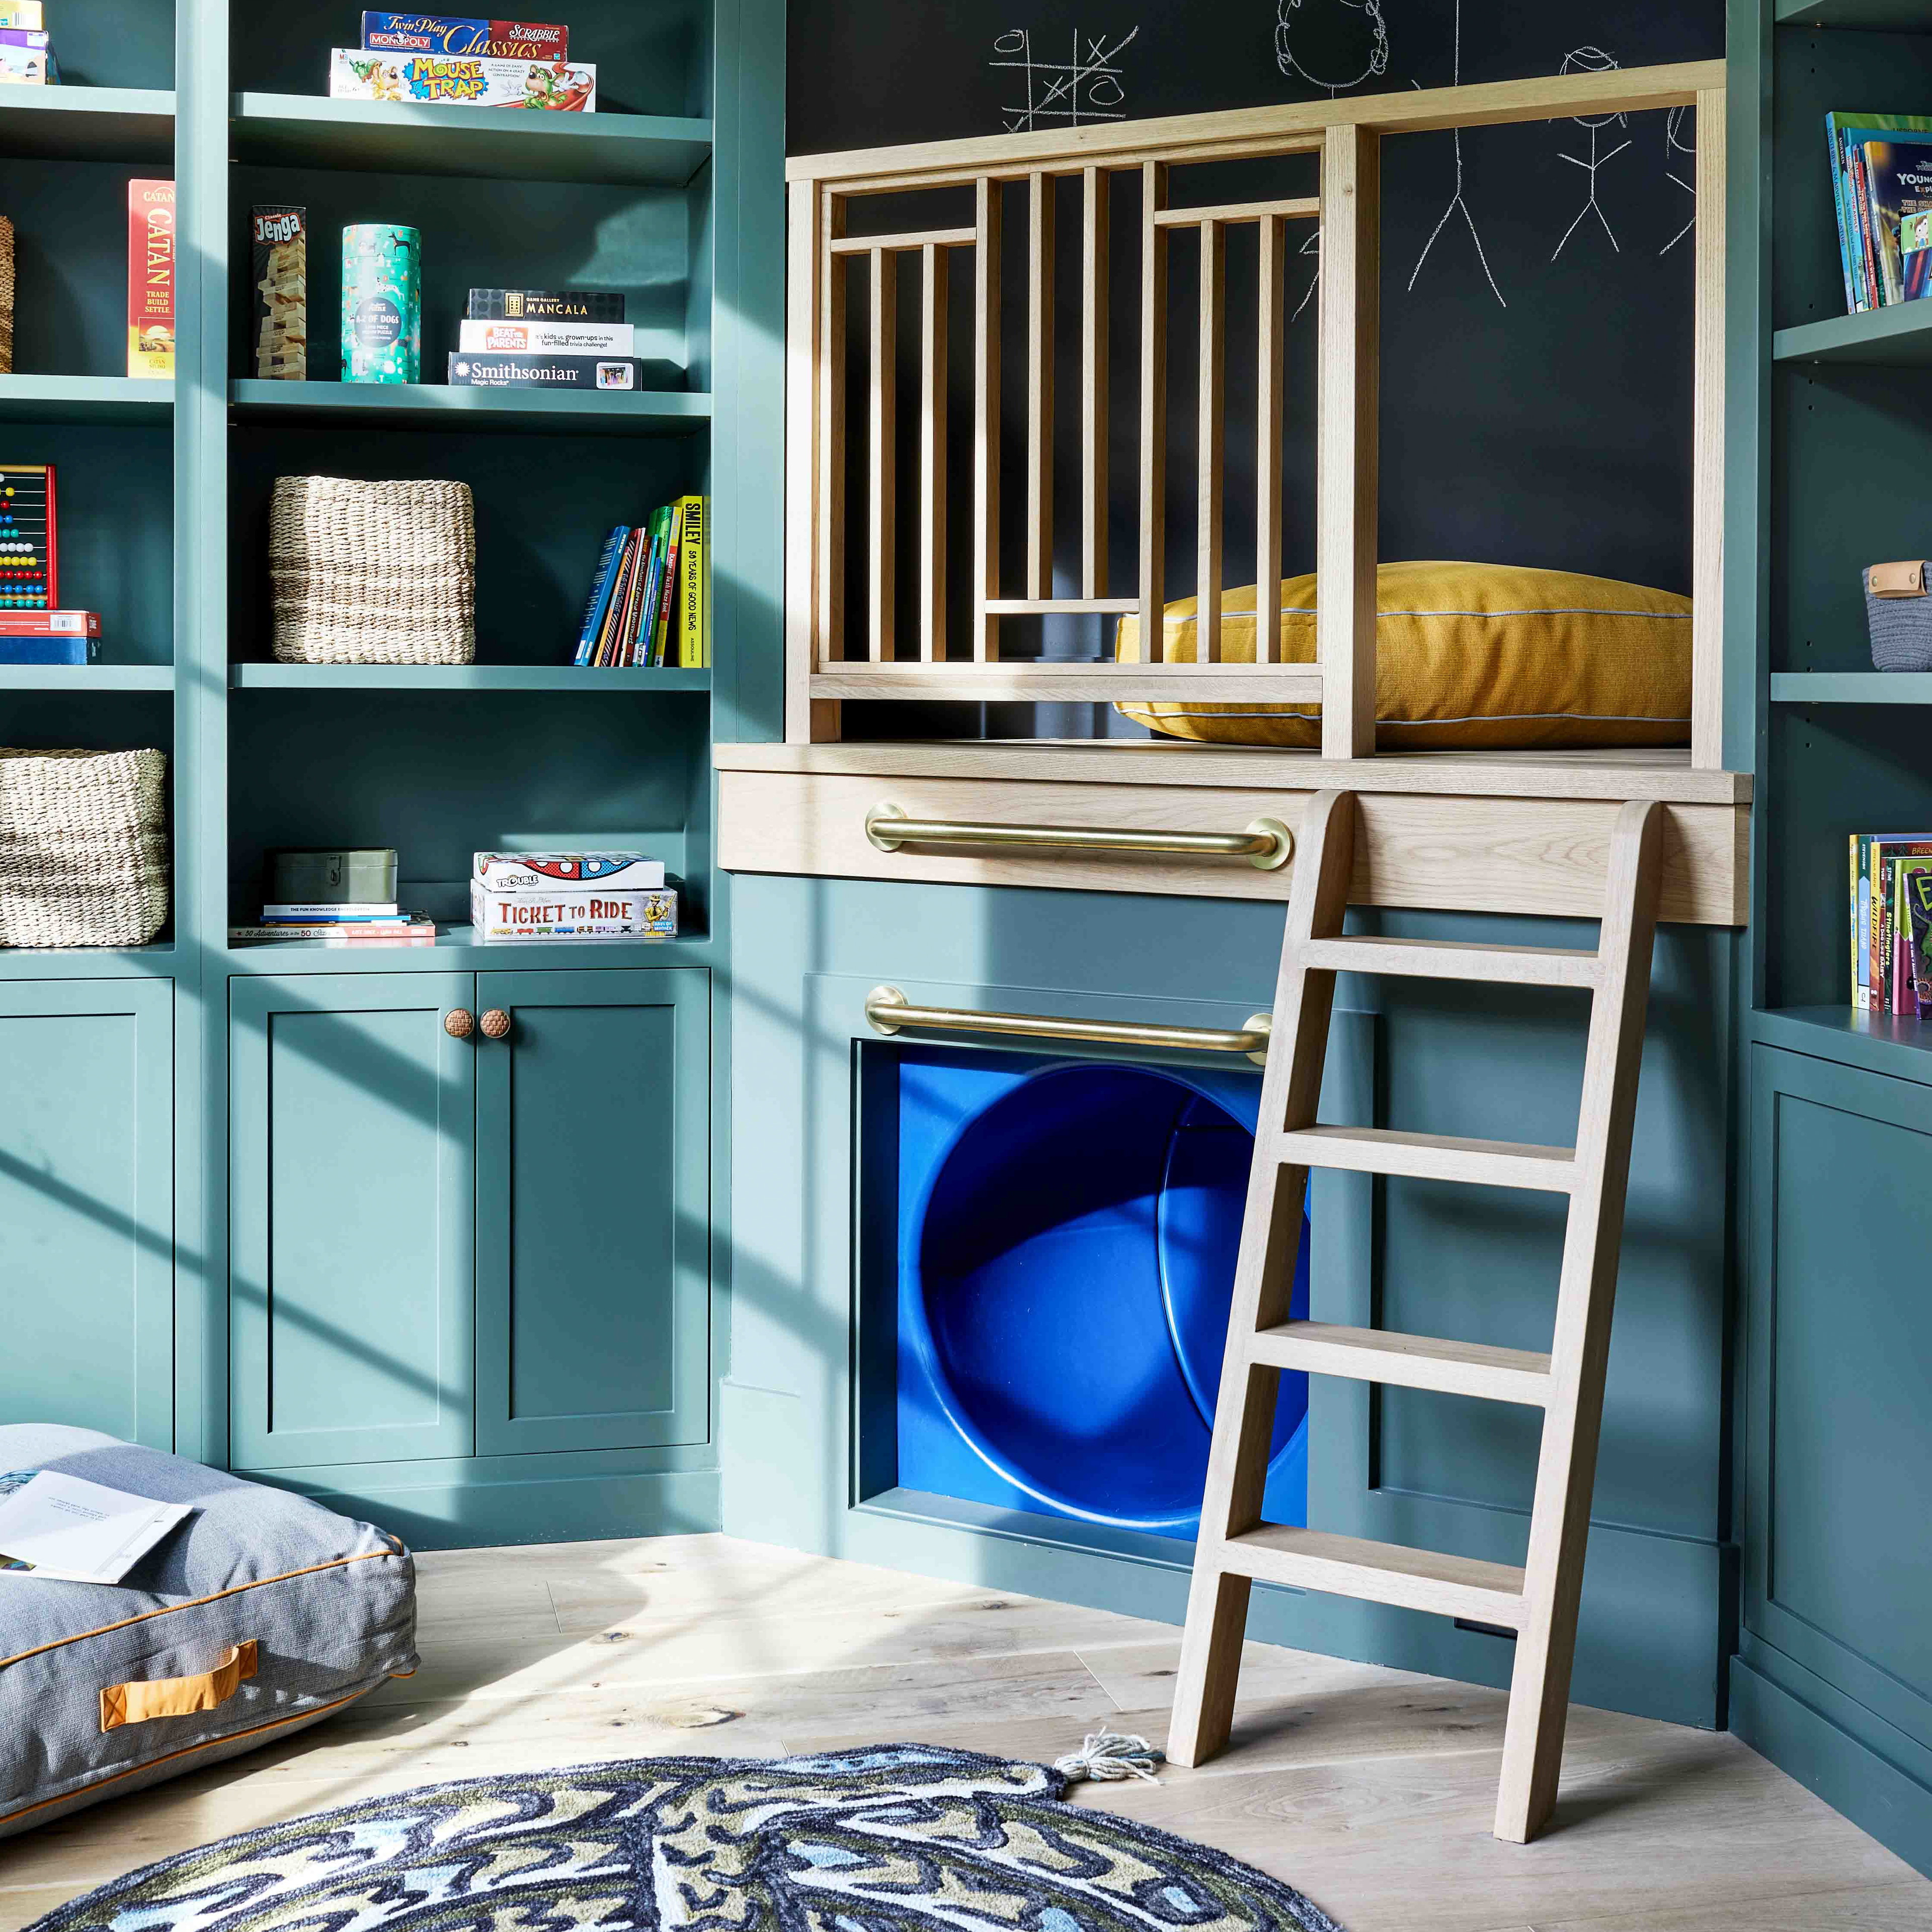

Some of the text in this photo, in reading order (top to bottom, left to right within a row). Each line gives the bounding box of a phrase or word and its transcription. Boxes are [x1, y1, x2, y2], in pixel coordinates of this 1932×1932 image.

[384, 16, 447, 37] Twin Play
[509, 24, 560, 41] SCRABBLE
[371, 35, 429, 47] MONOPOLY
[443, 25, 542, 58] Classics
[412, 57, 484, 82] MOUSE
[422, 78, 484, 101] TRAP
[257, 213, 300, 243] Jenga
[146, 208, 173, 286] CATAN
[146, 290, 170, 298] TRADE
[380, 314, 399, 324] DOGS
[526, 303, 588, 315] MANCALA
[487, 336, 526, 349] PARENTS
[493, 327, 516, 338] BEAT
[667, 553, 676, 574] Dinosaur
[685, 503, 701, 631] SMILEY 50 YEARS OF GOOD NEWS
[628, 611, 638, 644] UNDERPANTS
[496, 875, 539, 888] TROUBLE
[498, 899, 632, 924] TICKET TO RIDE
